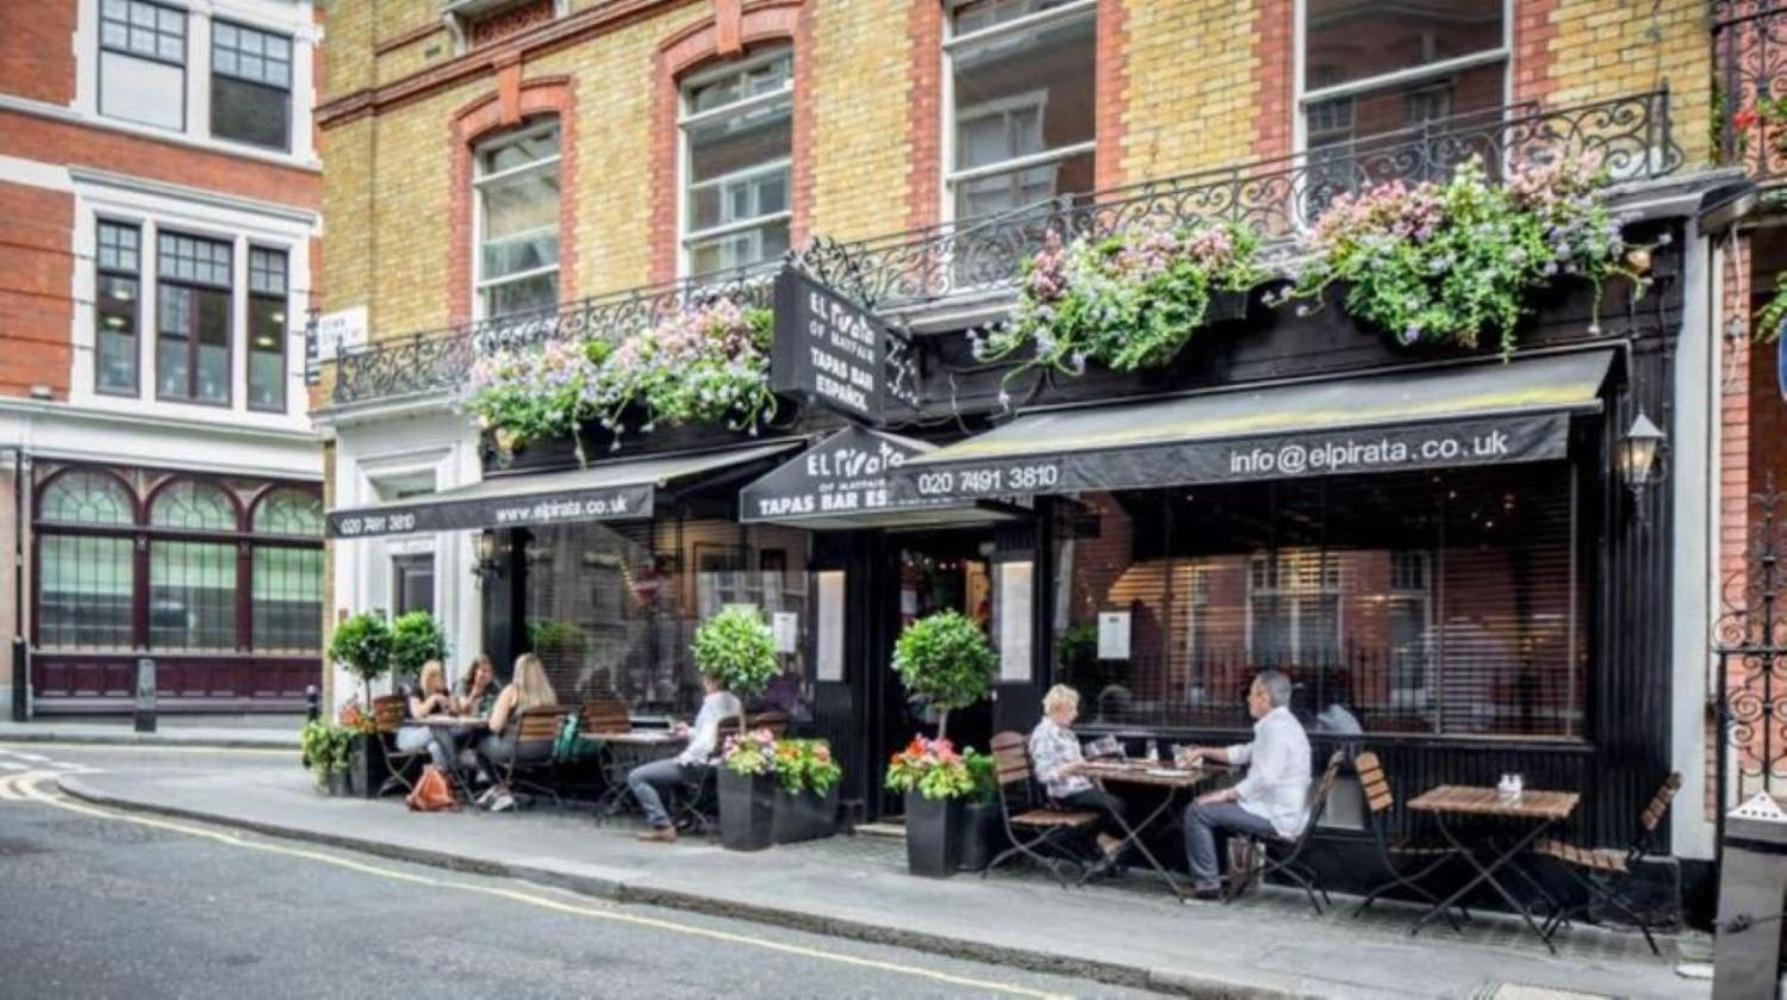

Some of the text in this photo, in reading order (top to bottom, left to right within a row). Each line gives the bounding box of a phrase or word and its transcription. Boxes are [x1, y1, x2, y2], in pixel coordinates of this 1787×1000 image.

[810, 292, 829, 319] EL
[810, 347, 874, 391] TAPAS BAR
[807, 454, 830, 476] EL
[818, 482, 834, 493] OF
[918, 465, 1057, 495] 020 7491 3810
[760, 495, 814, 516] TAPAS
[821, 491, 859, 510] BAR
